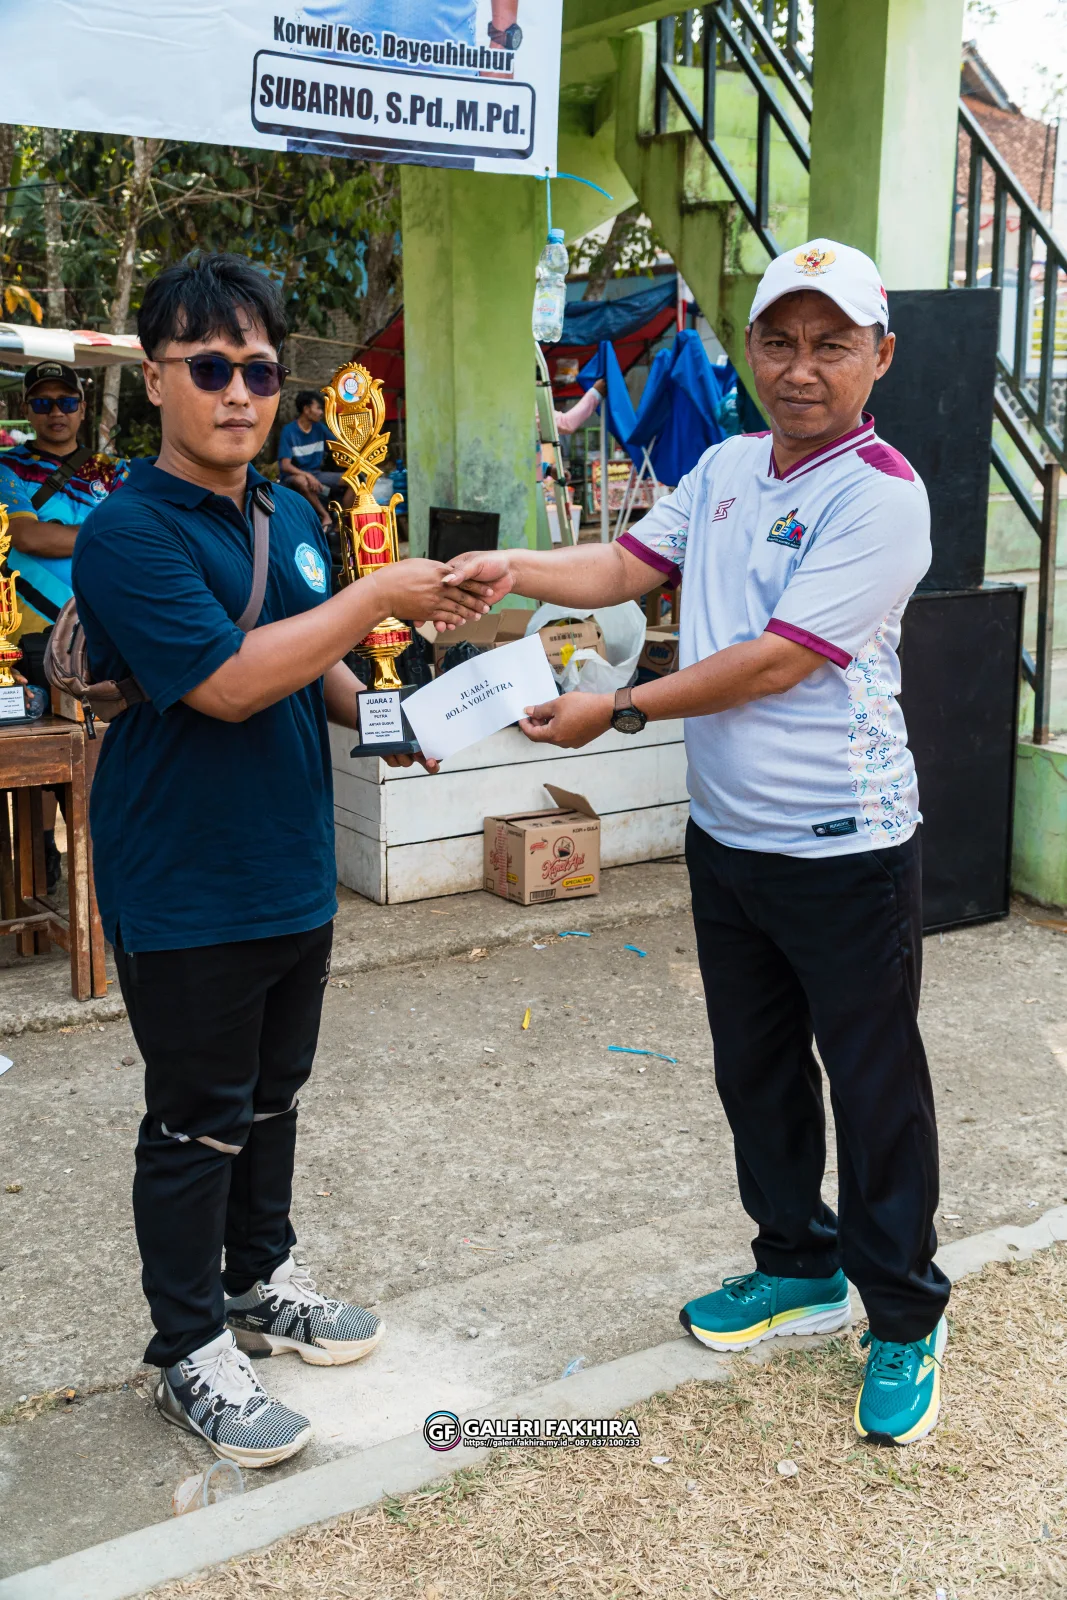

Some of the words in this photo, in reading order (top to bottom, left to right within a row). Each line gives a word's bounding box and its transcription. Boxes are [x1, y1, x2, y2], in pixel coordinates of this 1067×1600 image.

[273, 15, 333, 50] Korwil
[337, 26, 378, 57] Kec.
[382, 34, 515, 71] Dayeuhluhur
[259, 73, 379, 125] SUBARNO,
[445, 704, 468, 720] BOLA
[468, 693, 486, 707] VOLI
[485, 681, 514, 698] PUTRA
[460, 683, 485, 700] JUARA
[484, 679, 489, 687] 2
